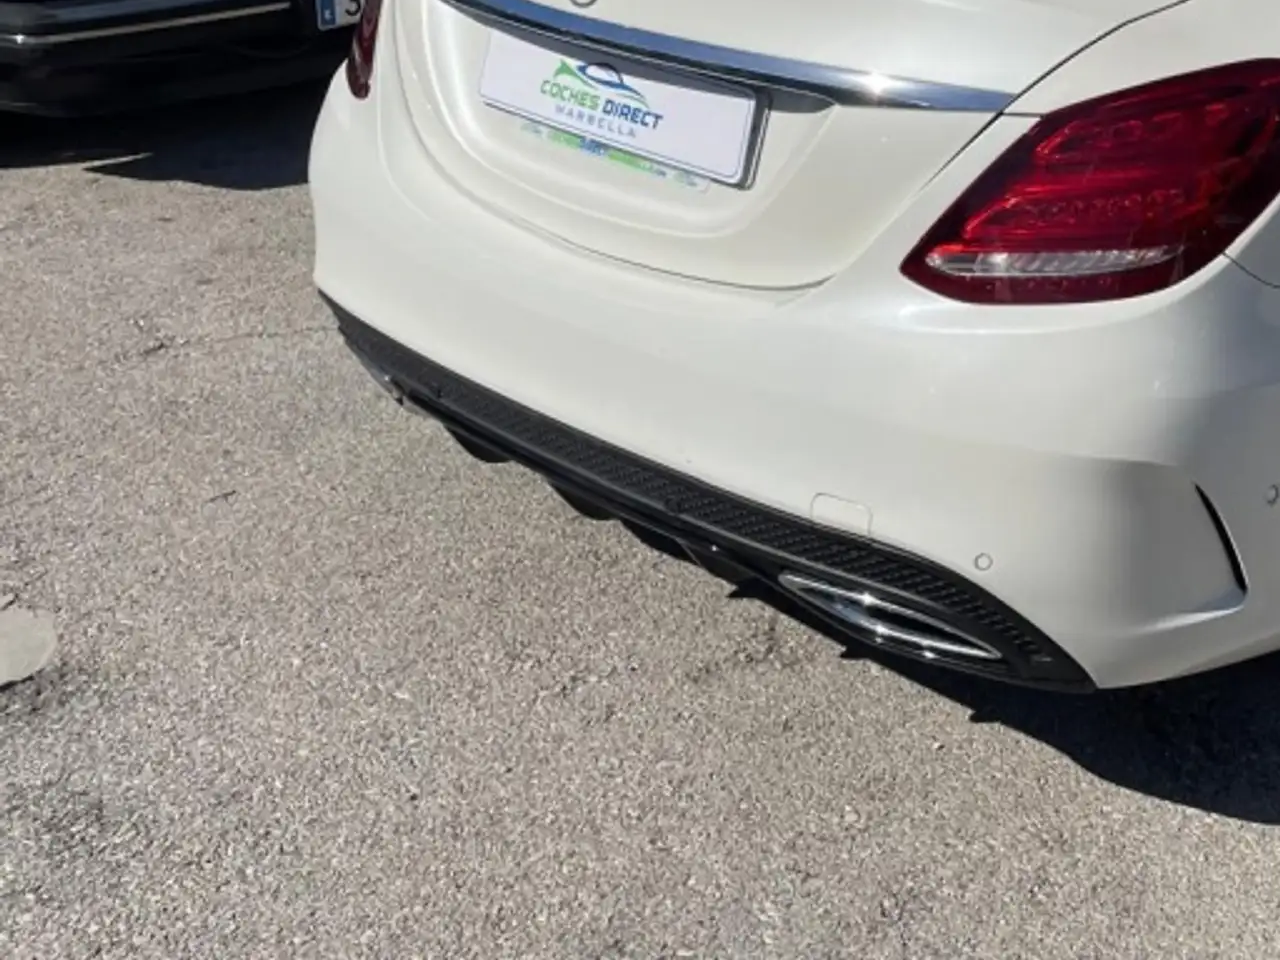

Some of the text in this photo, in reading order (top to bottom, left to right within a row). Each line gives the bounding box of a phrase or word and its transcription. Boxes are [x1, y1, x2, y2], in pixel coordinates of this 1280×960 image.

[539, 79, 664, 130] COCHES DIRECT
[554, 104, 636, 138] MARBELLA
